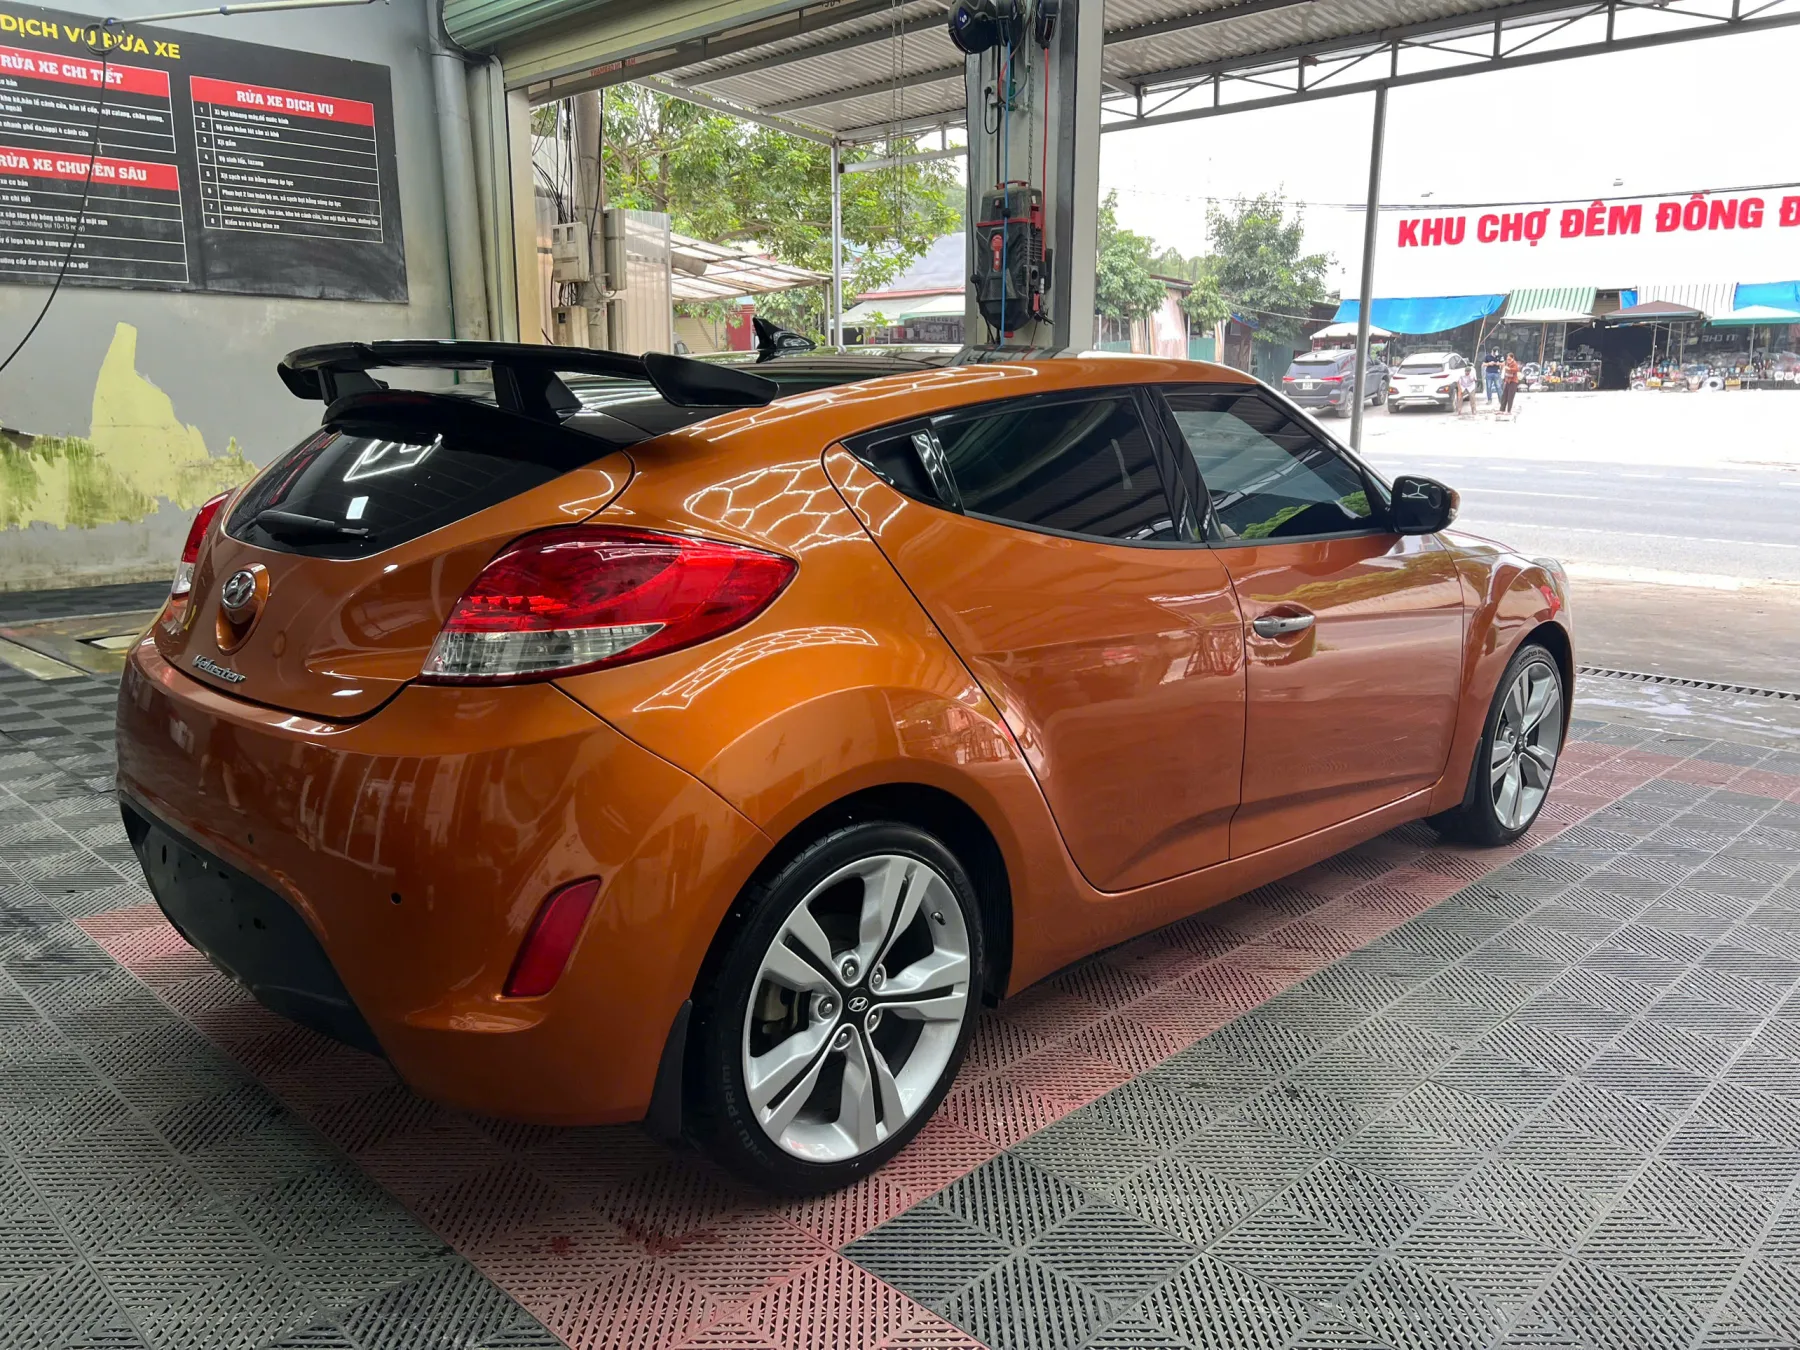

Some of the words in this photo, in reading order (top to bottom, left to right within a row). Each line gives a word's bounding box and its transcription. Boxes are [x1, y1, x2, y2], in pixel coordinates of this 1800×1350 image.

[0, 14, 59, 40] DỊCH
[153, 40, 181, 59] XE
[1, 53, 36, 72] RỬA
[38, 60, 59, 75] XE
[62, 64, 88, 79] CHI
[90, 67, 124, 84] TIẾT
[236, 89, 264, 105] RỬA
[266, 95, 283, 107] XE
[286, 97, 315, 111] DỊCH
[317, 102, 334, 116] VỤ
[0, 152, 29, 170] RỬA
[33, 158, 53, 171] XE
[56, 161, 115, 178] CHUYÊN
[119, 166, 147, 181] SÂU
[1398, 216, 1466, 247] KHU
[1477, 208, 1551, 247] CHỢ
[1560, 199, 1642, 239] ĐÊM
[192, 655, 246, 682] Veloster
